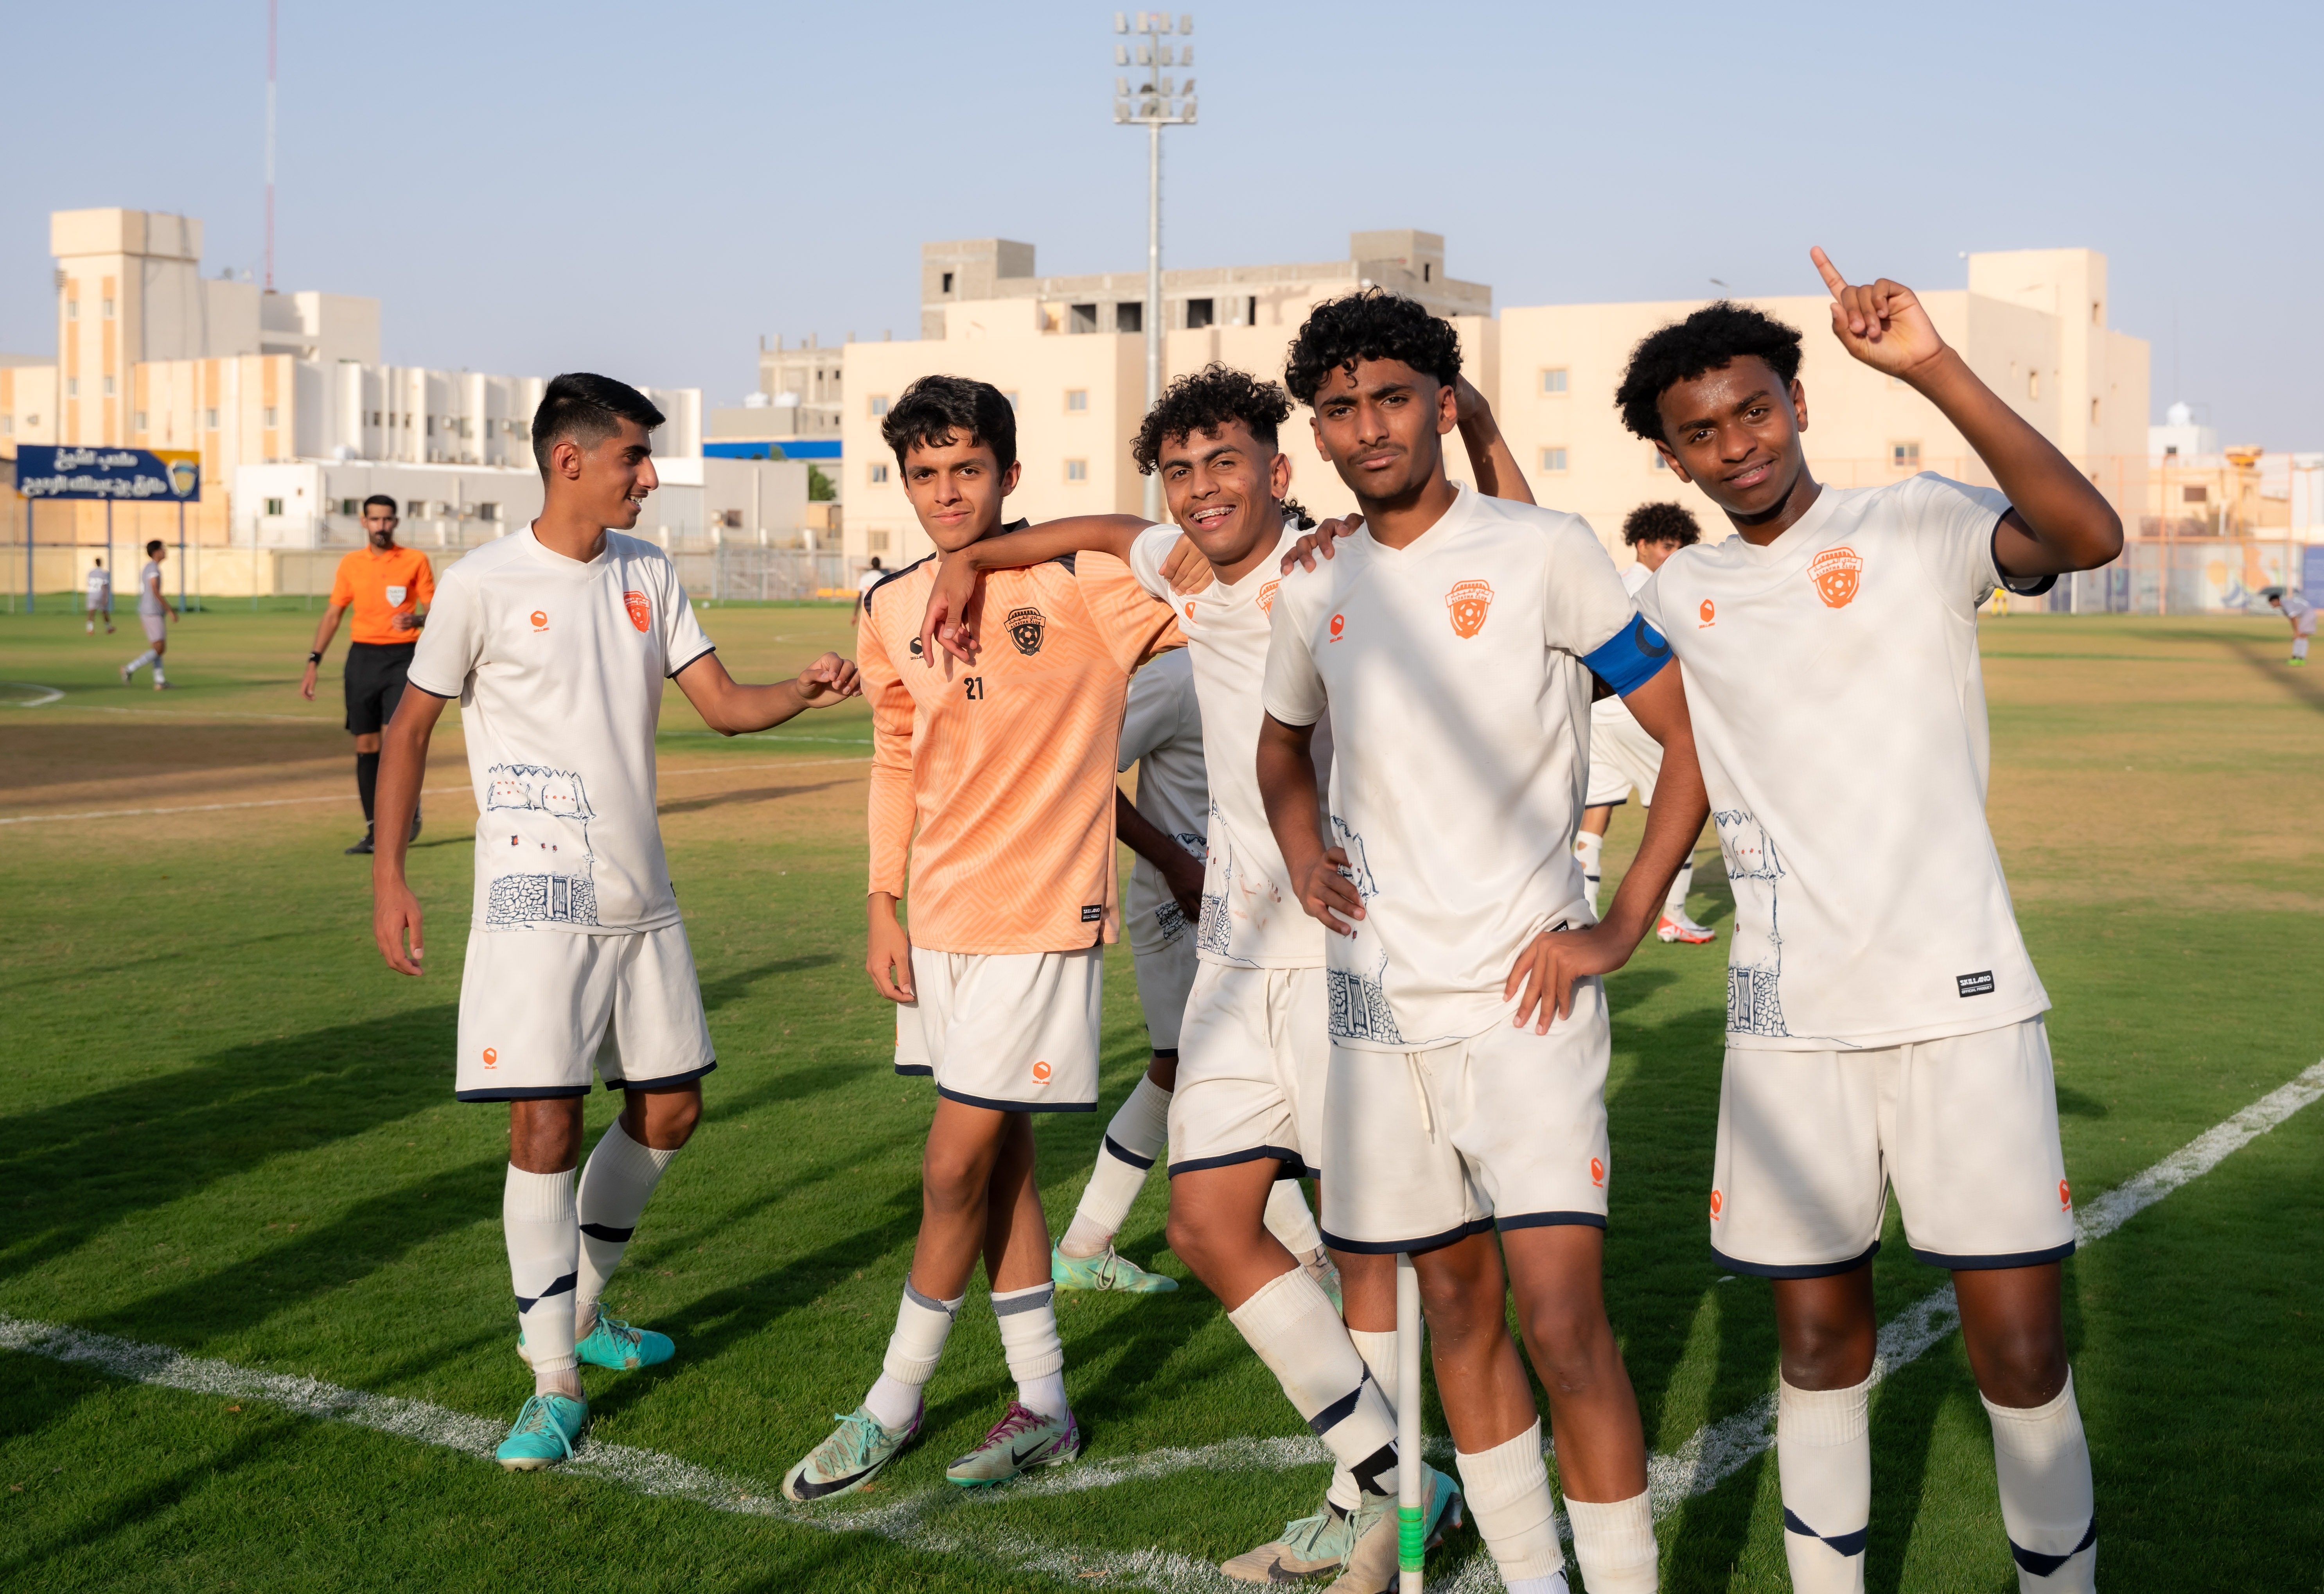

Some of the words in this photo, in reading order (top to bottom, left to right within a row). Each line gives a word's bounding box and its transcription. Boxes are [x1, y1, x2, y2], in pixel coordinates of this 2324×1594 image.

[54, 447, 97, 472] الشيخ
[97, 451, 138, 472] ملعب
[69, 475, 115, 497] عبدالله
[113, 478, 133, 497] بن
[132, 474, 167, 497] طارق
[1816, 565, 1839, 576] ALFAYHA
[963, 677, 983, 700] 21
[1959, 975, 1991, 986] SKILLANO
